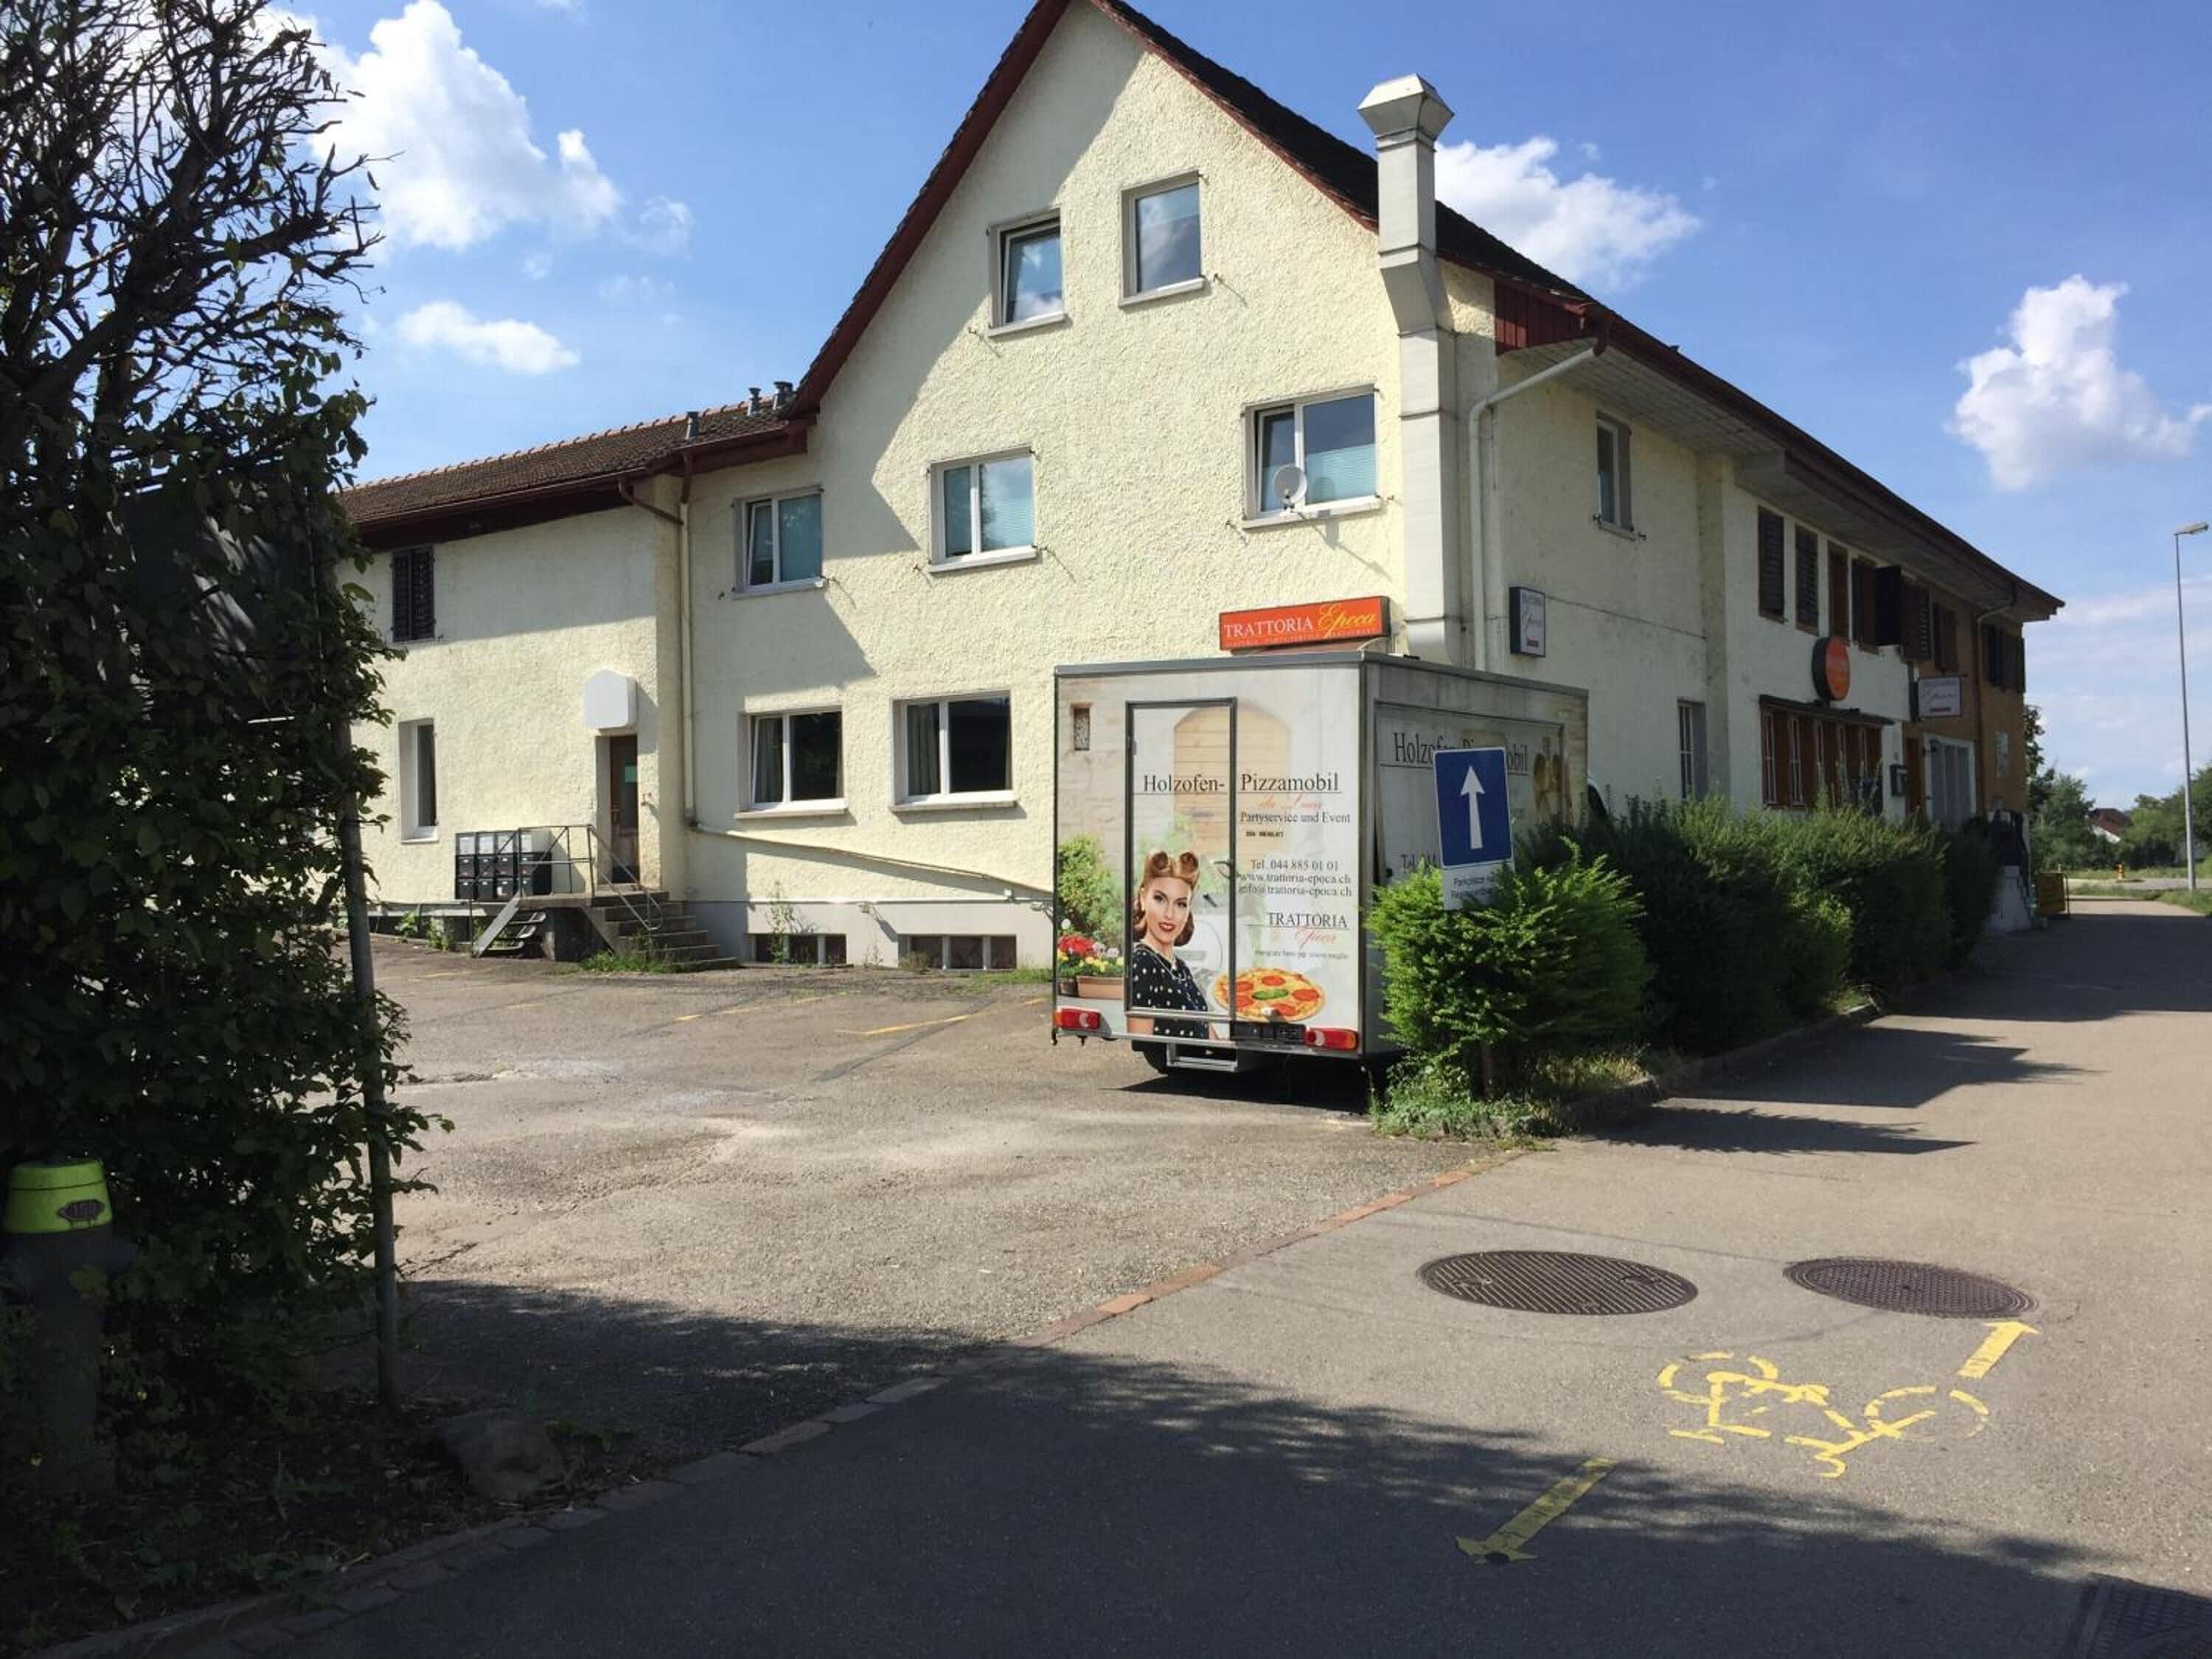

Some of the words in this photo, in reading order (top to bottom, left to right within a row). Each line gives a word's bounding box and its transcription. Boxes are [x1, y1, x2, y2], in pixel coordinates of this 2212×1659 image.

[1224, 616, 1313, 638] TRATTORIA
[1318, 602, 1377, 639] Epoca
[1144, 774, 1225, 793] Holzofen-
[1242, 773, 1338, 791] Pizzamobil
[1240, 812, 1297, 824] Partyservice
[1301, 813, 1318, 823] und
[1322, 813, 1351, 824] Event
[1270, 859, 1288, 869] 044
[1291, 860, 1309, 870] 885
[1312, 860, 1322, 871] 01
[1326, 860, 1338, 871] 01
[1267, 911, 1348, 928] TRATTORIA
